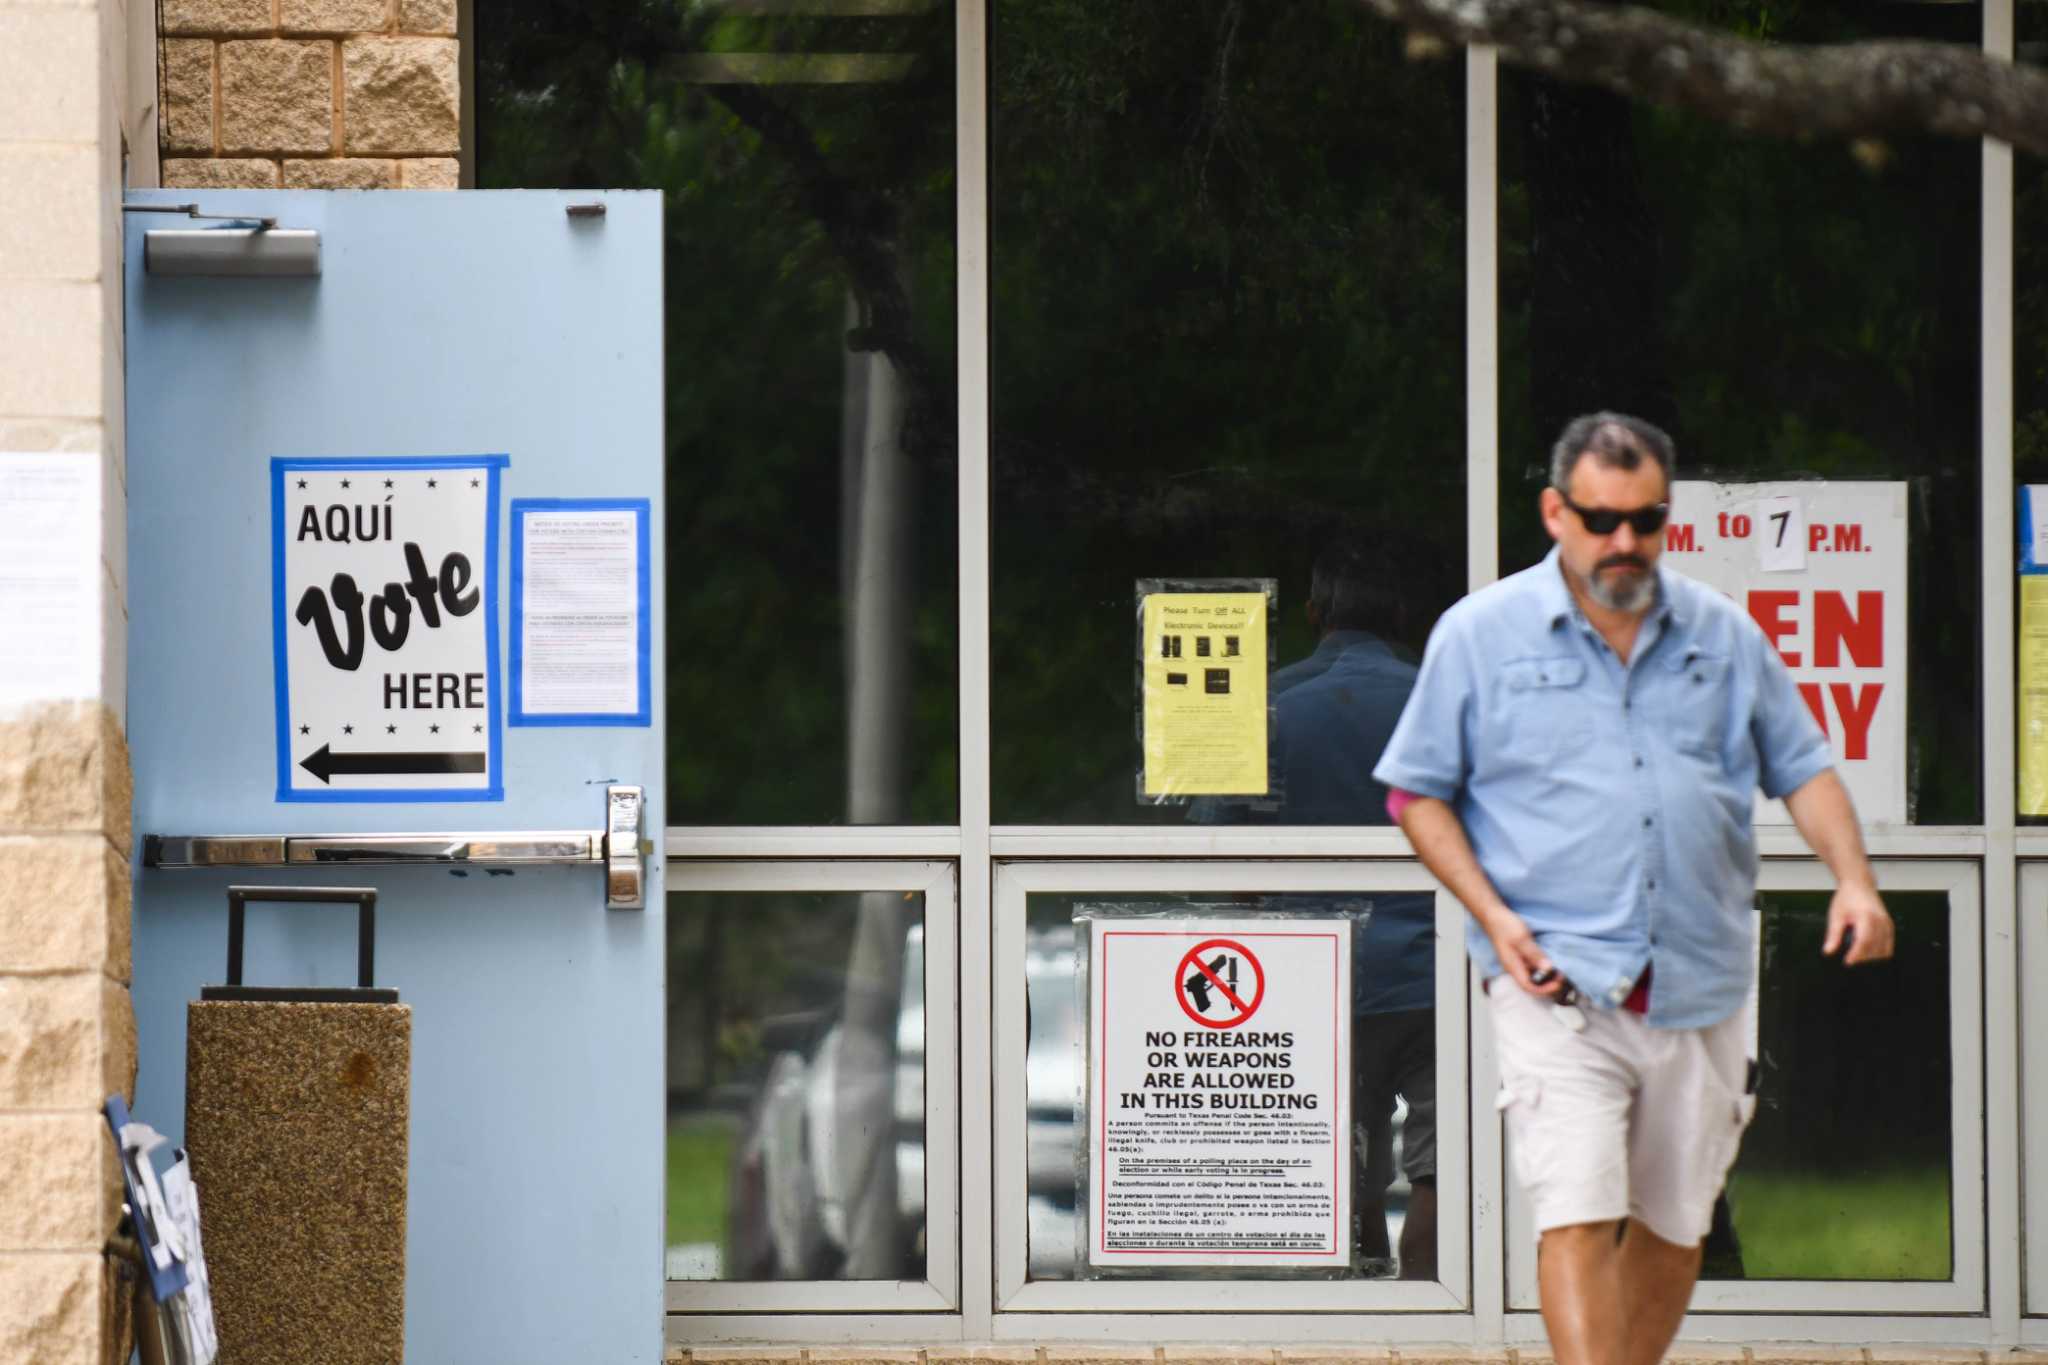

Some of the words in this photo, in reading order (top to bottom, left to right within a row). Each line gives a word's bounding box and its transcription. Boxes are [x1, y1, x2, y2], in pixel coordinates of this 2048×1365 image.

[296, 494, 394, 545] AQUÍ
[1717, 511, 1752, 539] to
[1769, 510, 1791, 548] 7
[1808, 523, 1873, 552] P.M.
[295, 541, 481, 672] Vote
[1163, 606, 1188, 614] Please
[1192, 606, 1211, 614] Turn
[1164, 621, 1204, 630] Electronic
[1722, 590, 1885, 668] EN
[383, 672, 485, 709] HERE
[1145, 1032, 1177, 1048] NO
[1183, 1032, 1294, 1048] FIREARMS
[1147, 1053, 1178, 1068] OR
[1185, 1053, 1291, 1068] WEAPONS
[1143, 1073, 1185, 1088] ARE
[1191, 1073, 1295, 1089] ALLOWED
[1120, 1093, 1145, 1109] IN
[1152, 1093, 1204, 1109] THIS
[1210, 1094, 1318, 1110] BUILDING
